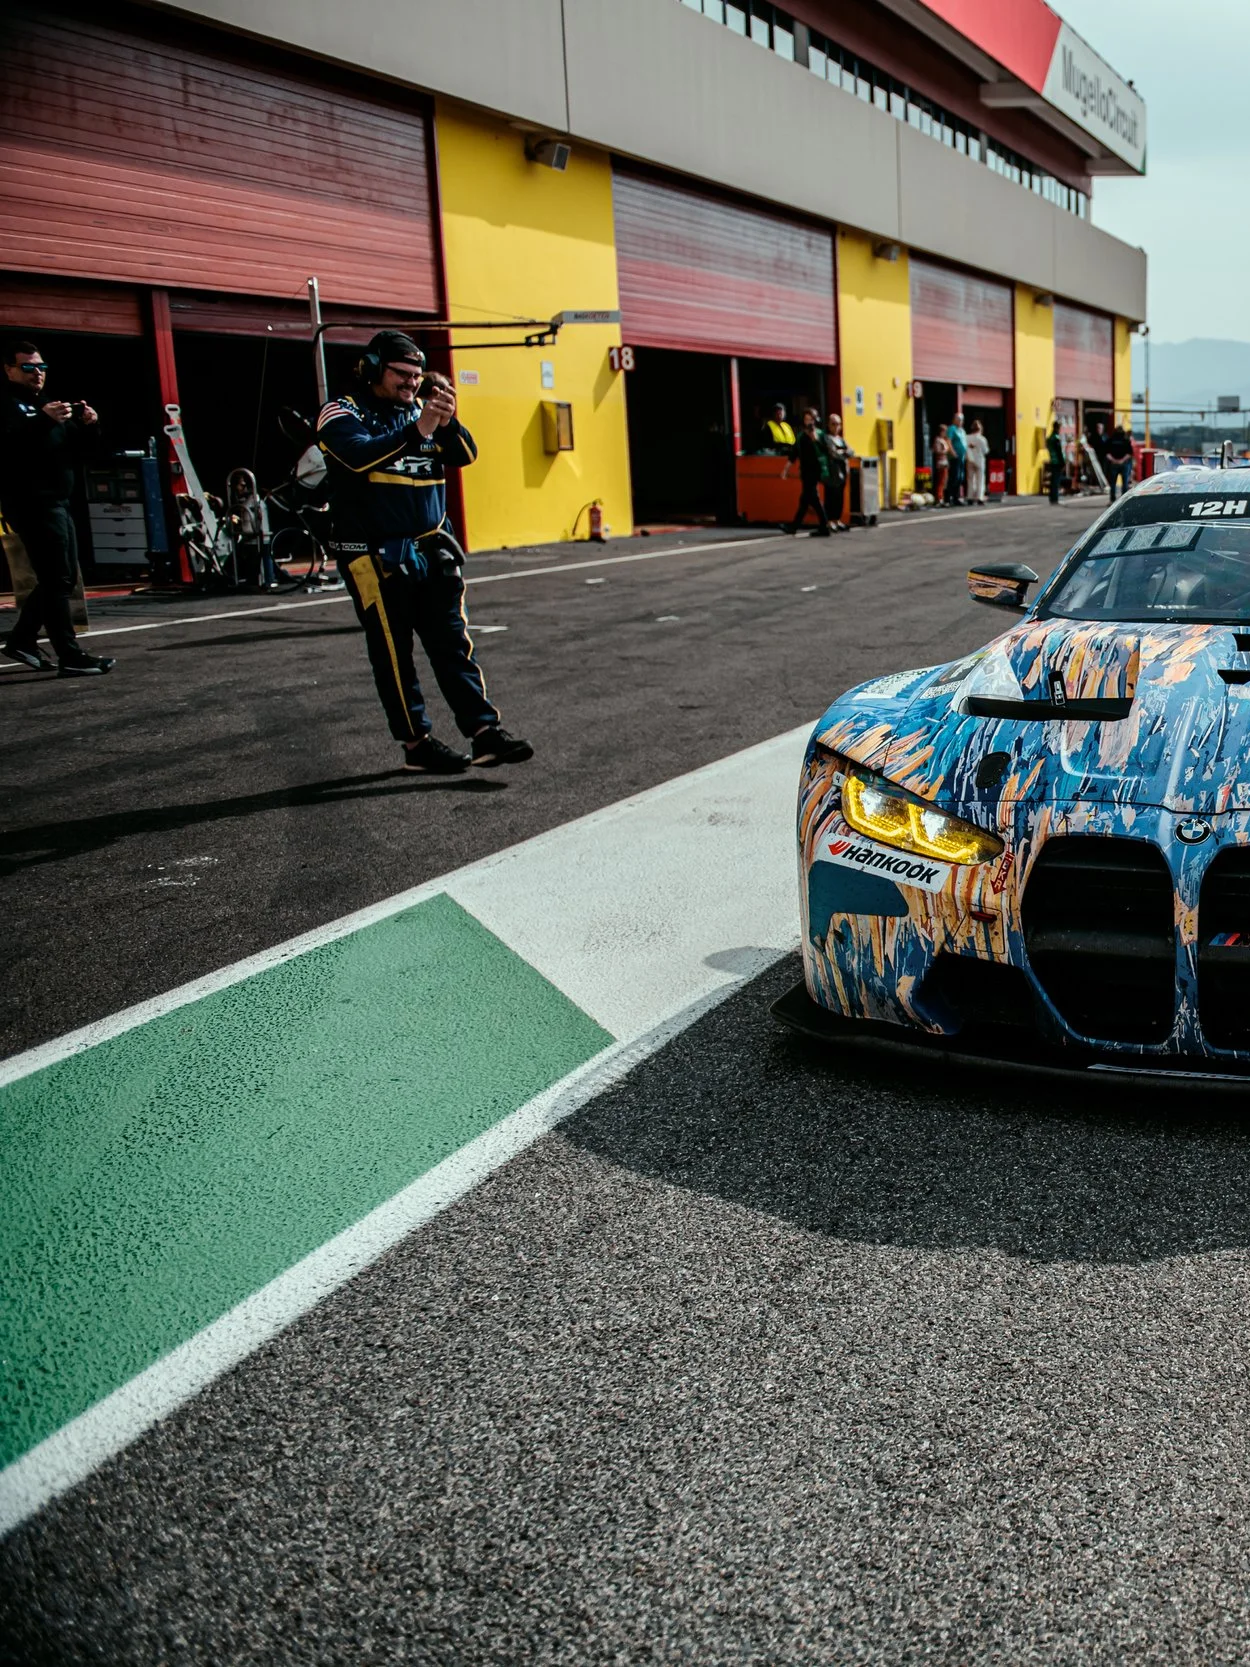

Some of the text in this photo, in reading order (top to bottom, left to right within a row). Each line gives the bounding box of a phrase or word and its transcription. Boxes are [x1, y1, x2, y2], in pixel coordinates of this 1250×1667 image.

[609, 346, 635, 370] 18
[908, 381, 923, 398] 19
[1189, 500, 1247, 517] 12H
